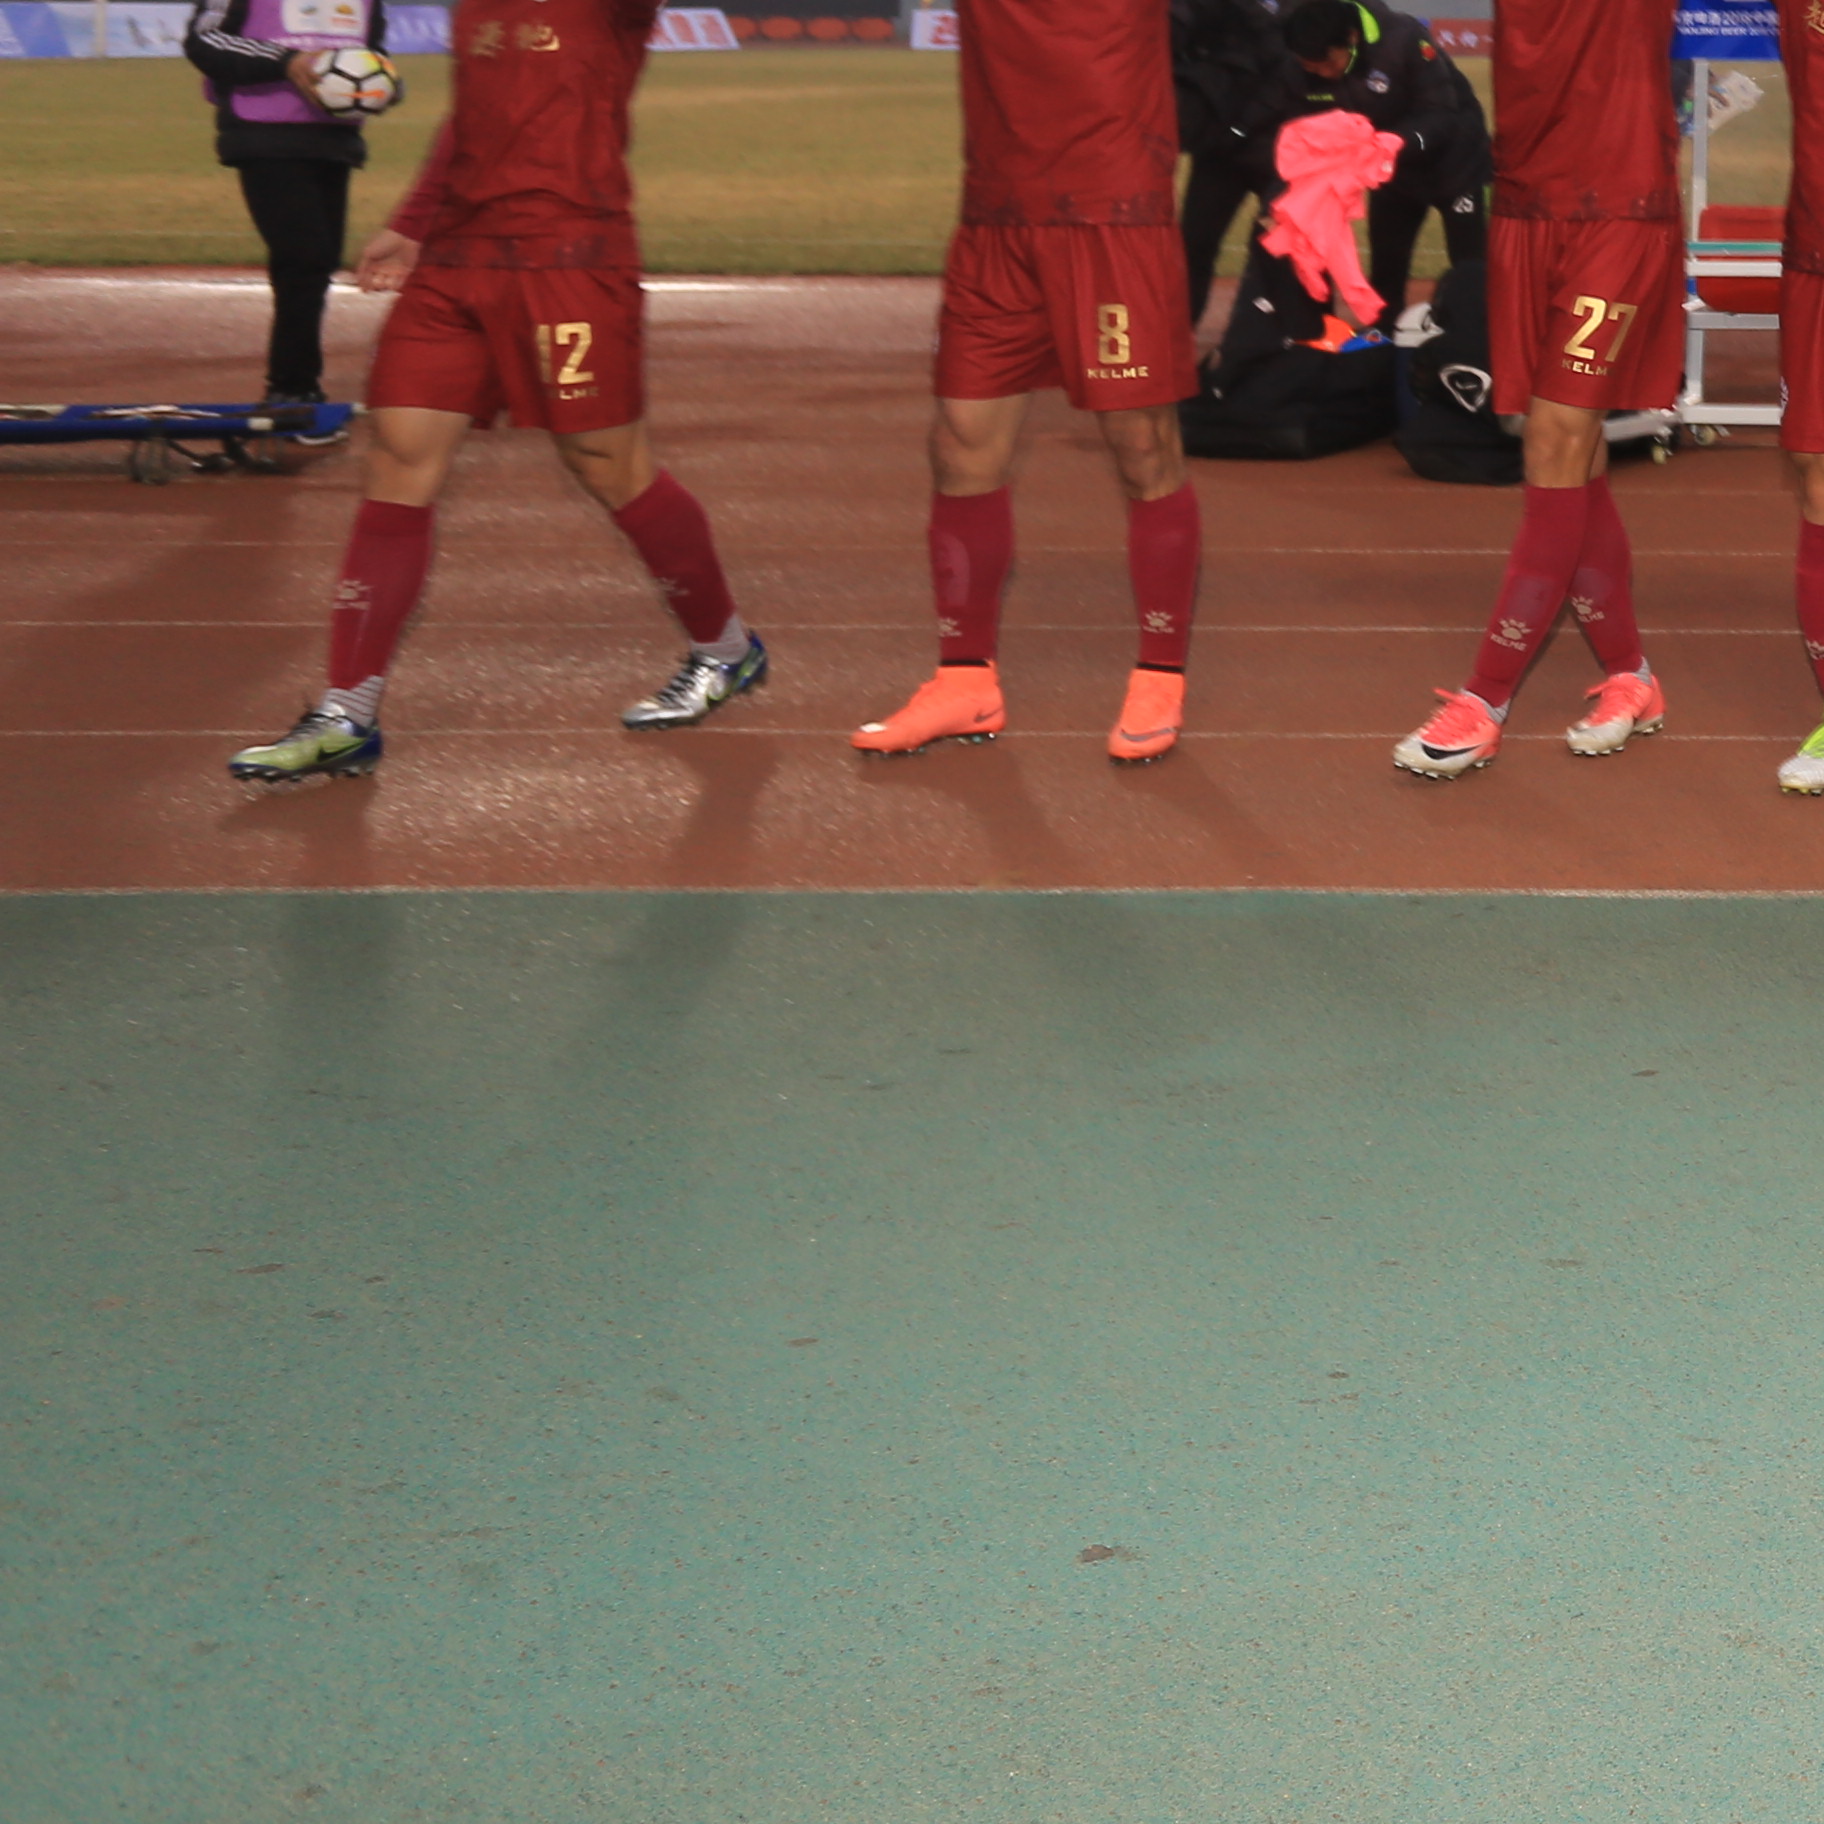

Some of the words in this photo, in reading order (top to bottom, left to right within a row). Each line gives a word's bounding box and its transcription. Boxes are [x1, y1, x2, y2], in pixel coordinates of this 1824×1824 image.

[1098, 304, 1130, 364] 8
[1564, 295, 1638, 362] 27
[536, 321, 594, 384] 12
[1562, 359, 1609, 376] KELM
[1087, 366, 1149, 379] KELME
[1490, 634, 1527, 651] KELME
